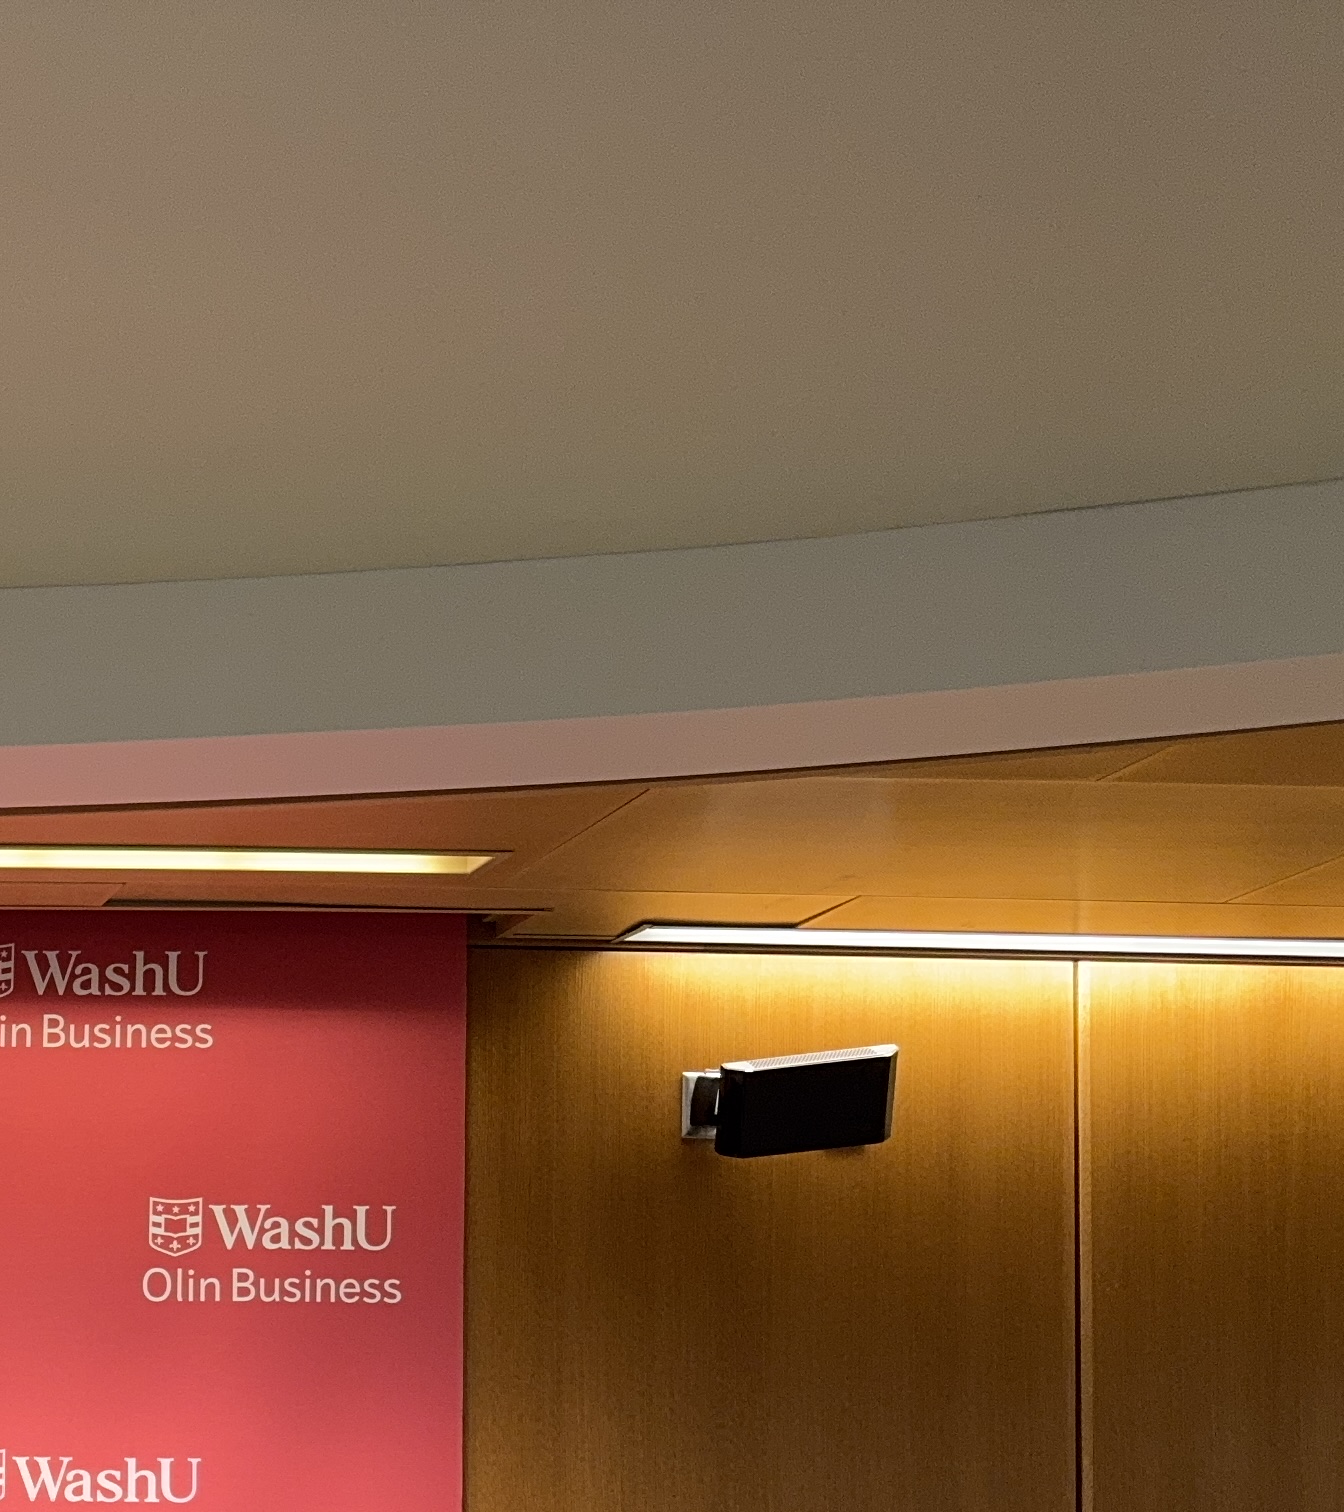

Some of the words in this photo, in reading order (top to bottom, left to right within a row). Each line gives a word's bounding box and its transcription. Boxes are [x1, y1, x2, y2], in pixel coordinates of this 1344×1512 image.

[20, 950, 208, 996] WashU
[42, 1013, 214, 1049] Business
[208, 1204, 397, 1251] WashU
[142, 1267, 221, 1303] Olin
[231, 1267, 402, 1304] Business
[11, 1455, 202, 1504] WashU
